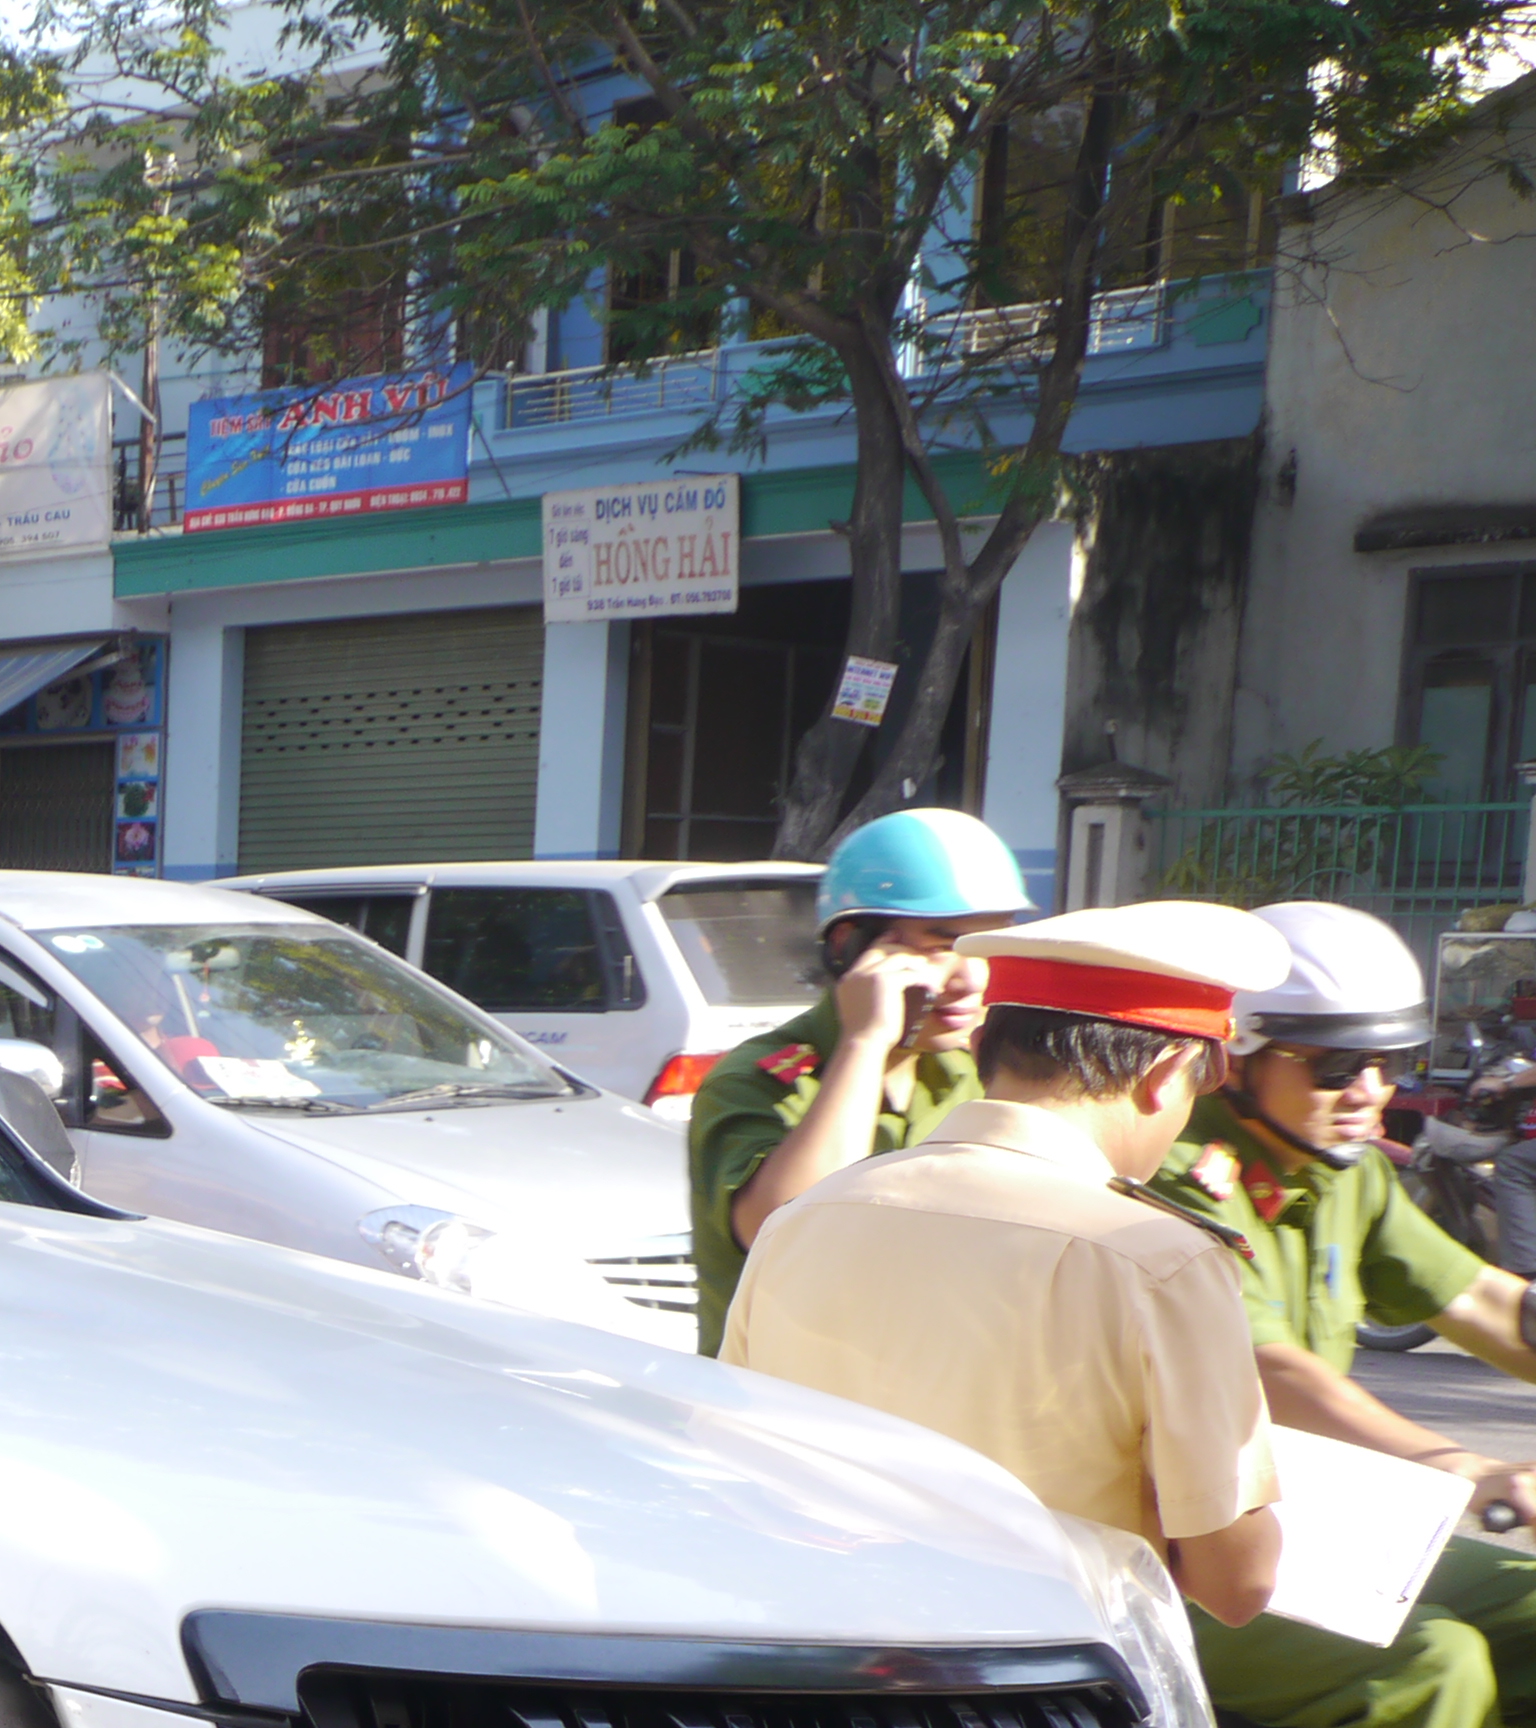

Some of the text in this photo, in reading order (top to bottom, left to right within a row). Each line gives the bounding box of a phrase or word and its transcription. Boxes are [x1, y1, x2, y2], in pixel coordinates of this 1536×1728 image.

[596, 496, 632, 524] DỊCH
[637, 492, 658, 520] VỤ
[677, 516, 731, 580] HẢI
